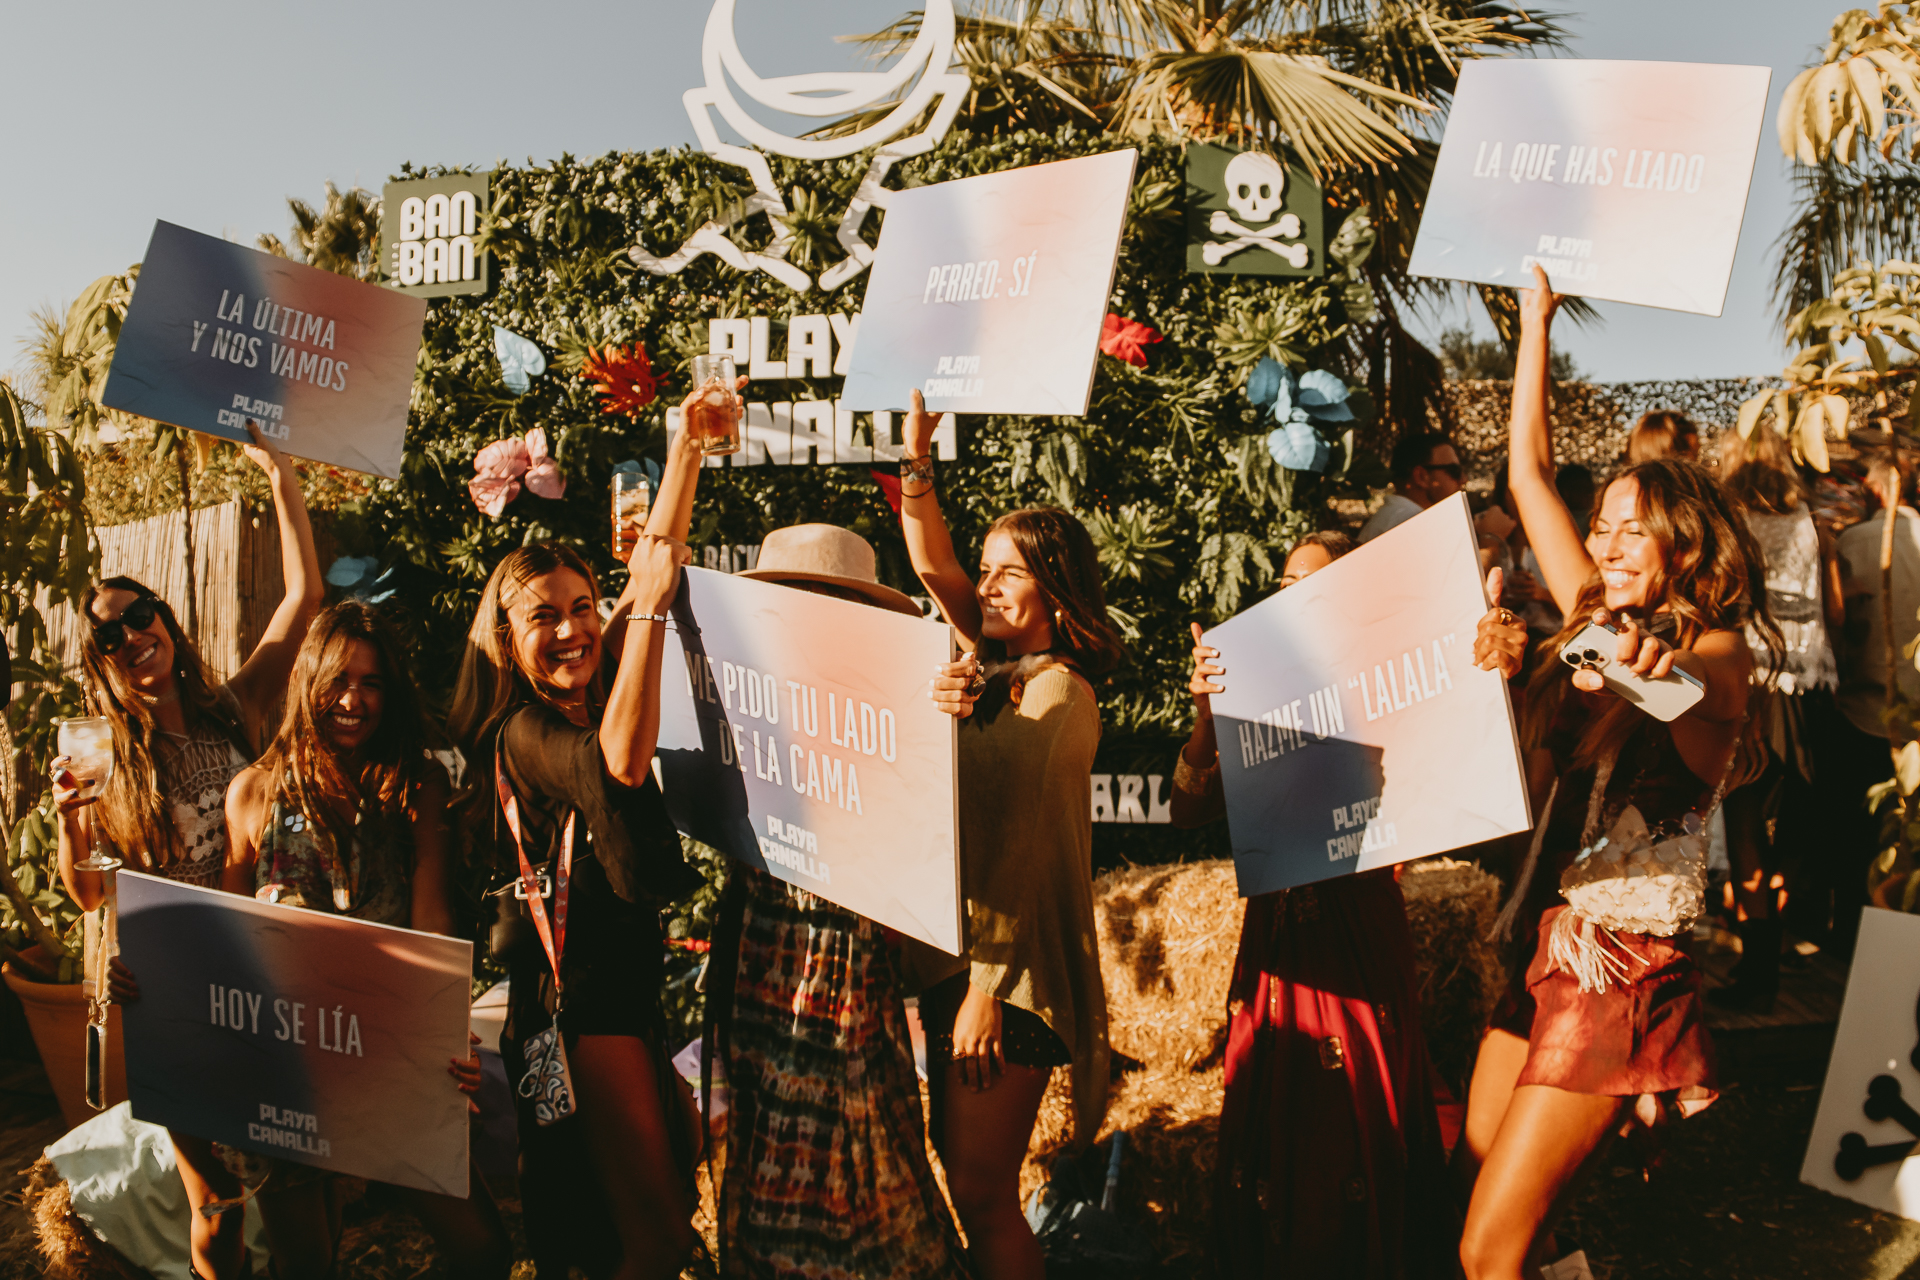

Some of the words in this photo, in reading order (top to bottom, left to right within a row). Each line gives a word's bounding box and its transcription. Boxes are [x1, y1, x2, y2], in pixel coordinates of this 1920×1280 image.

[1473, 140, 1503, 179] LA
[1509, 141, 1562, 184] QUE
[1562, 145, 1618, 187] HAS
[1622, 149, 1706, 194] LIADO
[400, 190, 476, 241] BAN
[399, 235, 475, 286] BAN
[1536, 234, 1593, 258] PLAYA
[923, 259, 1003, 304] PERREO:
[1008, 250, 1038, 298] SÍ
[216, 289, 243, 325] LA
[252, 296, 337, 351] ÚLTIMA
[189, 320, 211, 353] Y
[211, 326, 263, 369] NOS
[270, 342, 349, 392] VAMOS
[709, 312, 863, 380] PLAY
[936, 355, 981, 375] PLAYA
[231, 393, 284, 421] PLAYA
[923, 378, 985, 397] CANALLA
[684, 650, 717, 704] ME
[722, 660, 779, 725] PIDO
[786, 679, 818, 738] TU
[828, 692, 897, 763] LADO
[1238, 699, 1307, 768] HAZME
[1308, 684, 1346, 740] UN
[718, 718, 747, 773] DE
[753, 729, 783, 786] LA
[789, 743, 863, 816] CAMA
[766, 814, 818, 855] PLAYA
[1332, 796, 1383, 831] PLAYA
[758, 835, 831, 885] CANALLA
[1326, 822, 1398, 862] CANALLA
[209, 984, 263, 1035] HOY
[273, 997, 307, 1045] SE
[318, 1004, 364, 1057] LÍA
[248, 1122, 331, 1158] CANALLA
[259, 1103, 318, 1133] PLAYA
